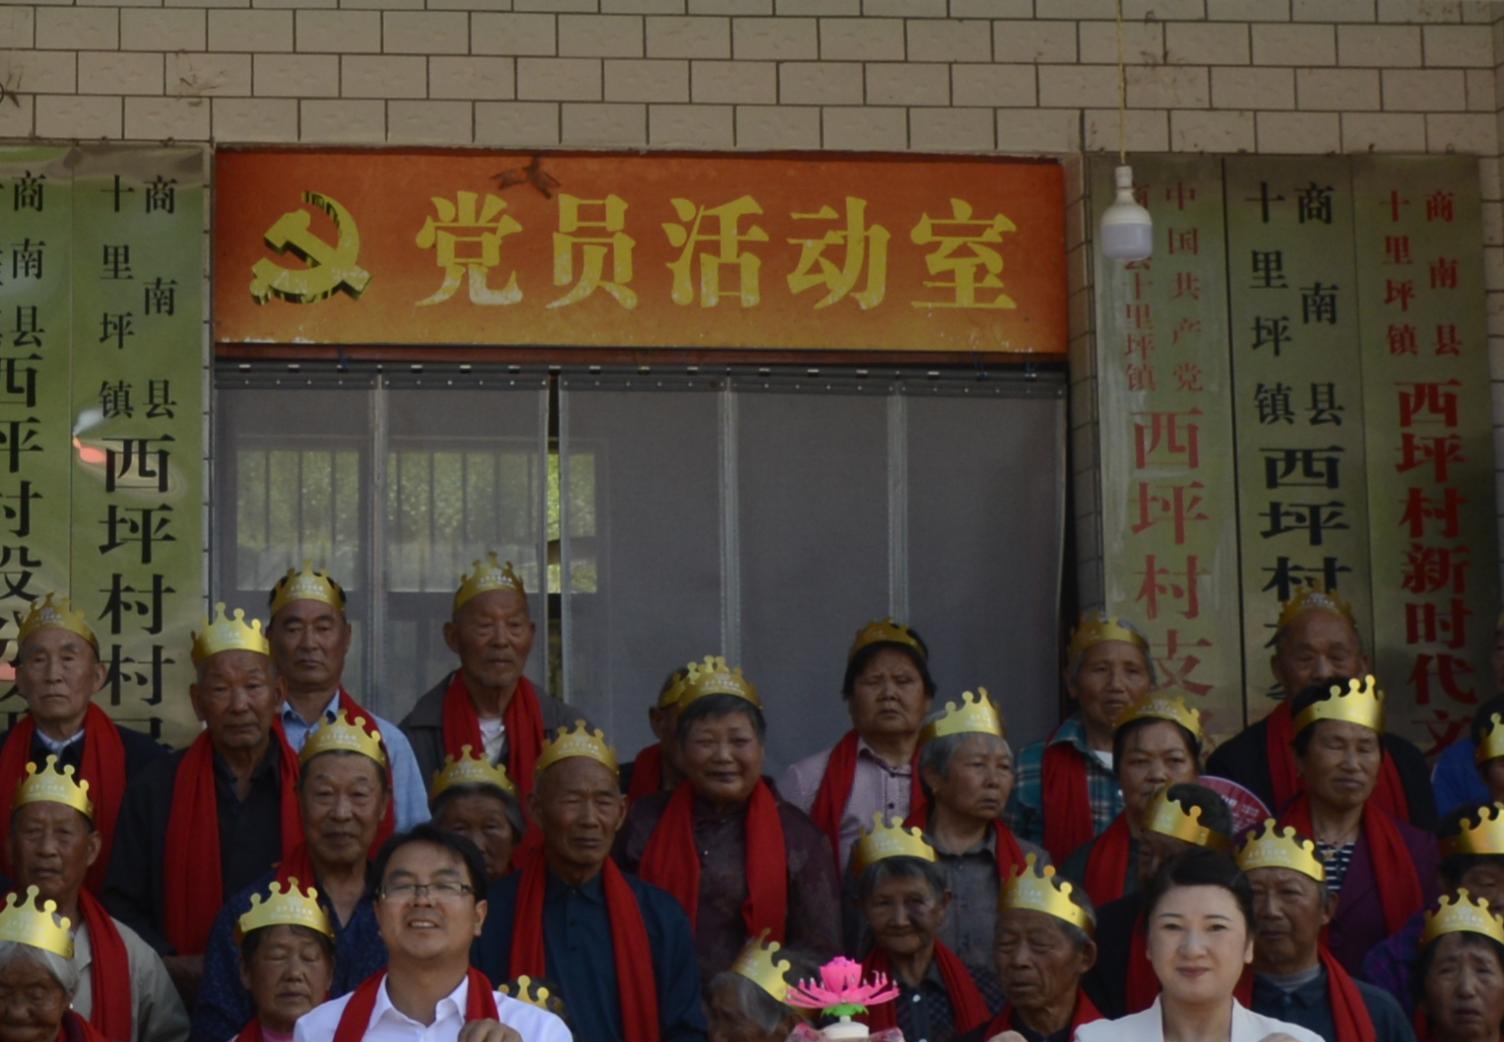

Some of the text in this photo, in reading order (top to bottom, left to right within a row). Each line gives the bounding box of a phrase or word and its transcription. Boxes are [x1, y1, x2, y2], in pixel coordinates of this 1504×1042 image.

[10, 170, 46, 349] 商南县
[98, 173, 135, 420] 十里坪镇
[143, 176, 178, 420] 商南县
[413, 191, 1018, 311] 党员活动室
[1165, 181, 1204, 393] 中国共产党
[1245, 181, 1295, 426] 十里坪镇
[1295, 182, 1345, 427] 商南县
[1382, 189, 1419, 357] 十里坪镇
[1425, 190, 1462, 357] 商南县
[1130, 407, 1212, 697] 西坪村支
